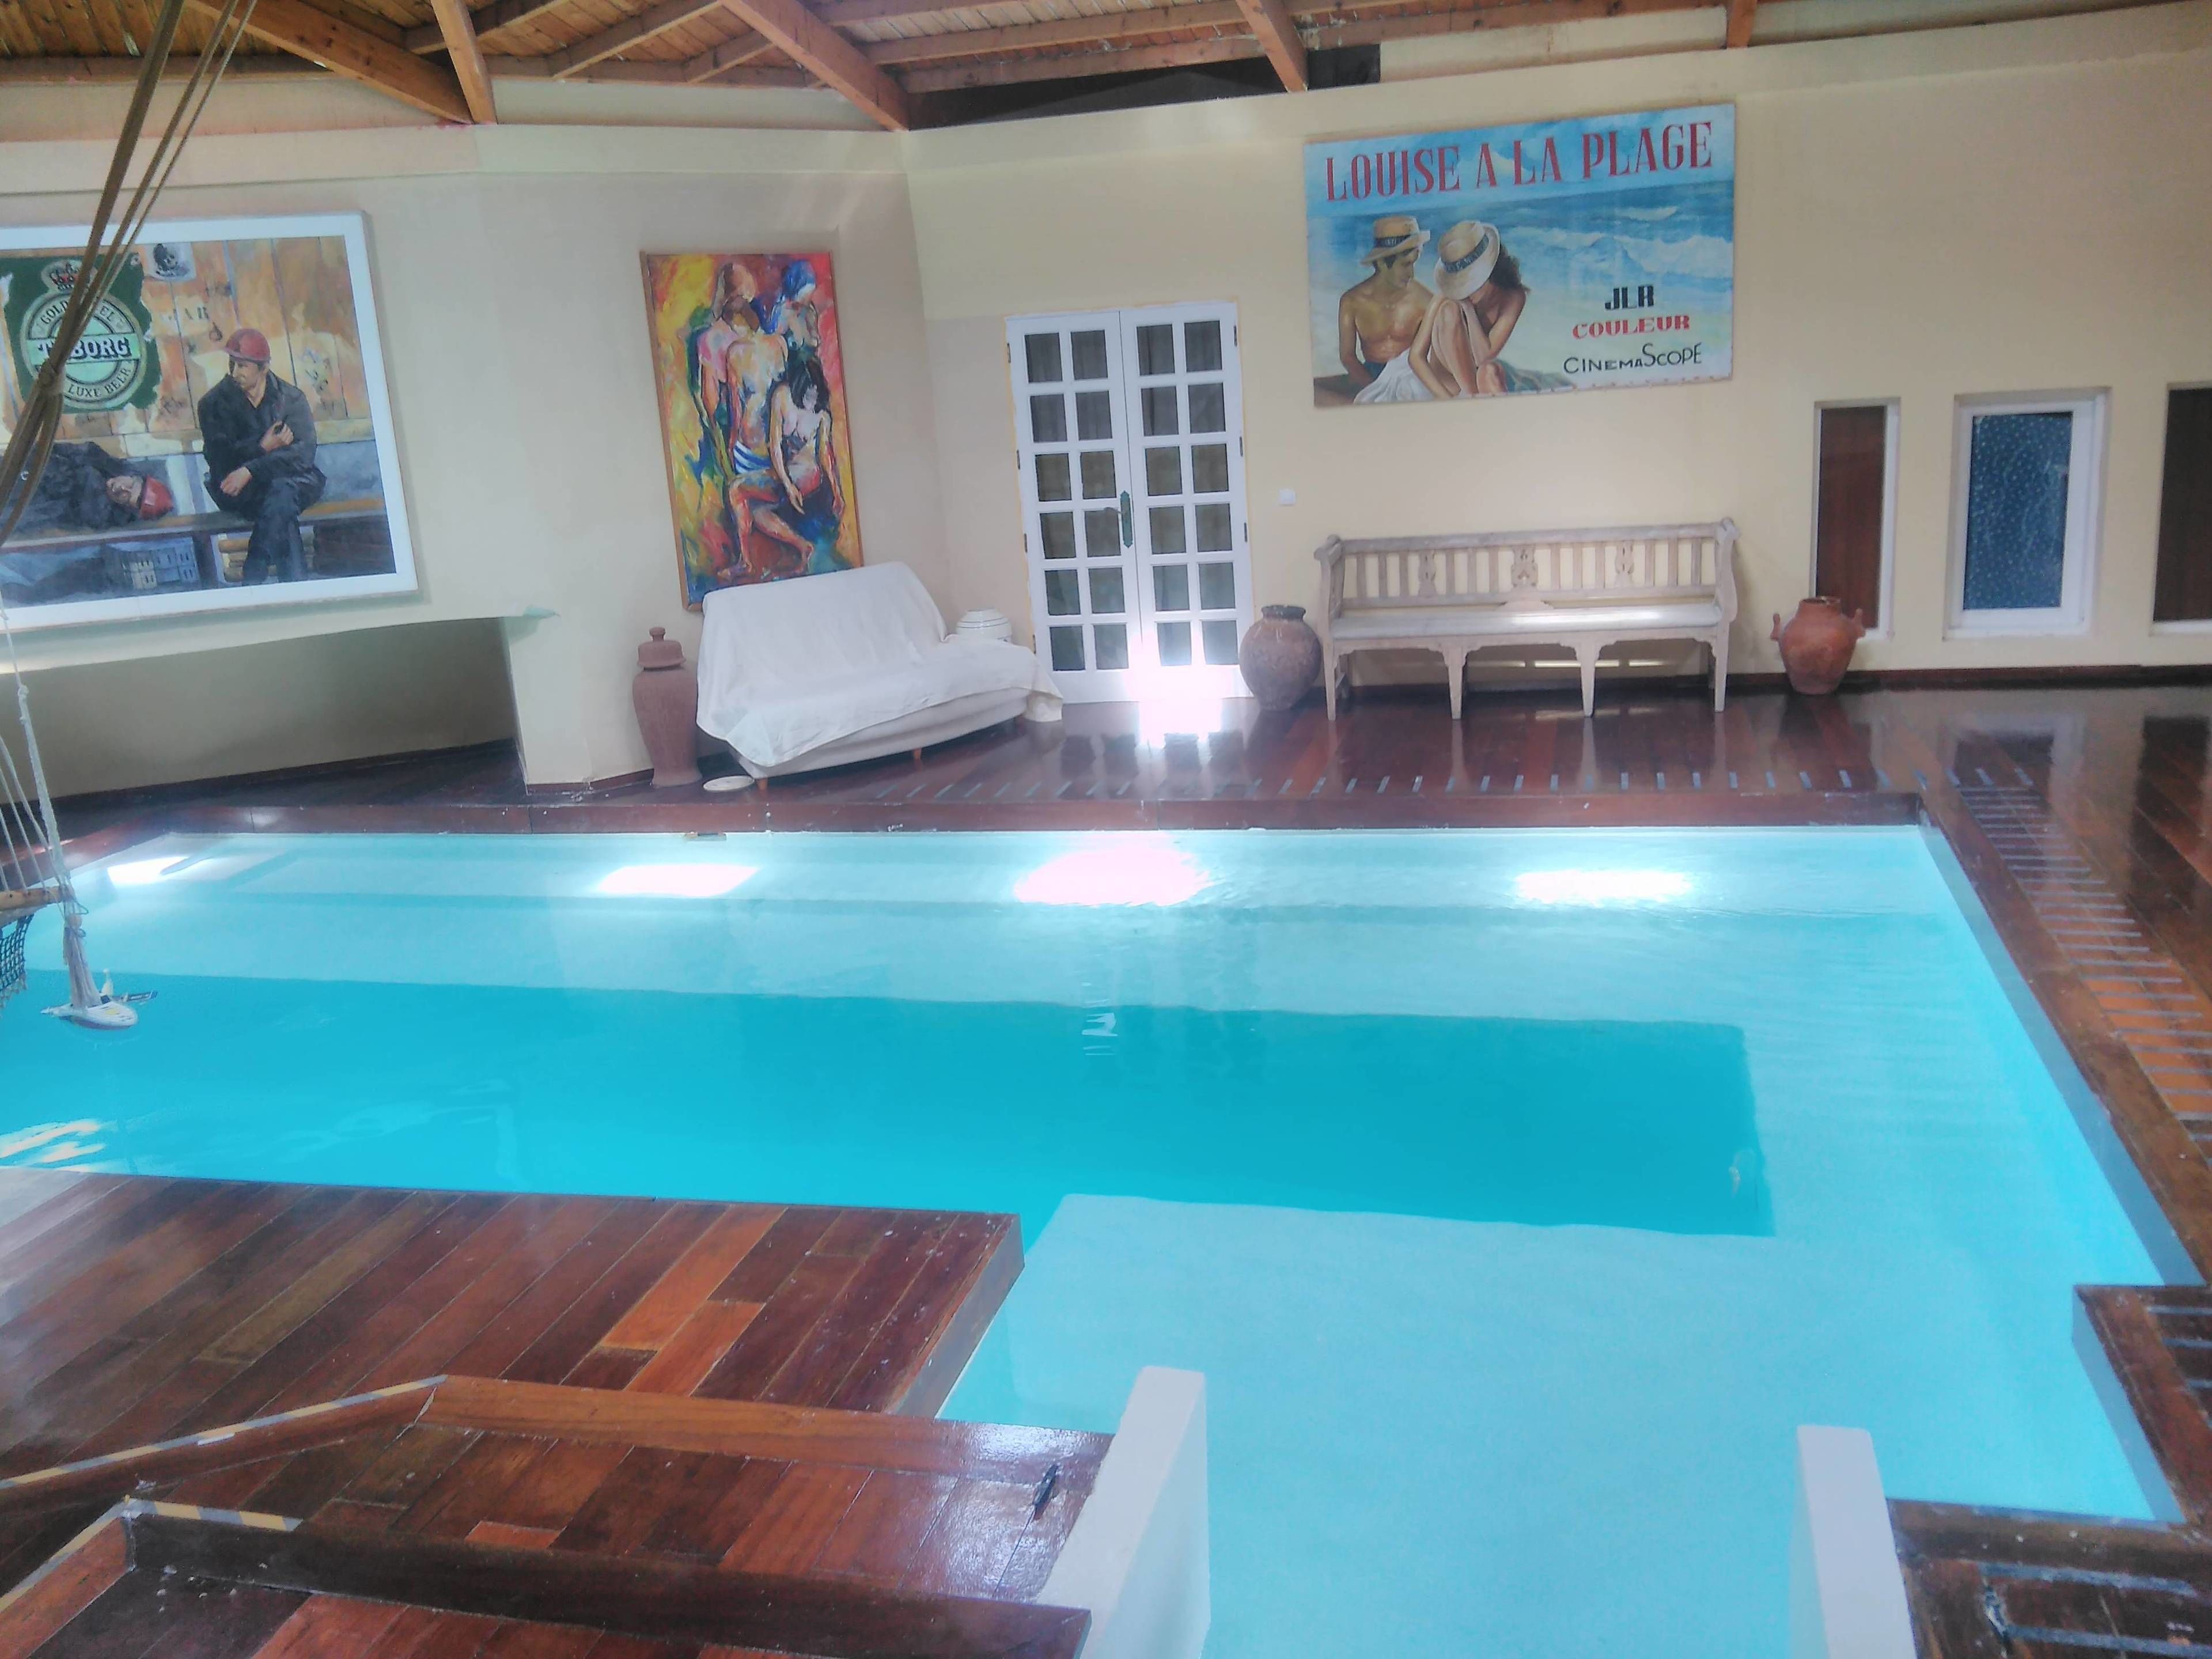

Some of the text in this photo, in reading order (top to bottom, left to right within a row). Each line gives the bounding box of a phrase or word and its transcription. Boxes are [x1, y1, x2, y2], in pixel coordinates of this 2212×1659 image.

[1326, 121, 1712, 201] LOUISE A LA PLAGE
[1572, 314, 1690, 340] COULEUR
[36, 336, 132, 360] TBORG
[67, 368, 132, 398] LUXE BEER
